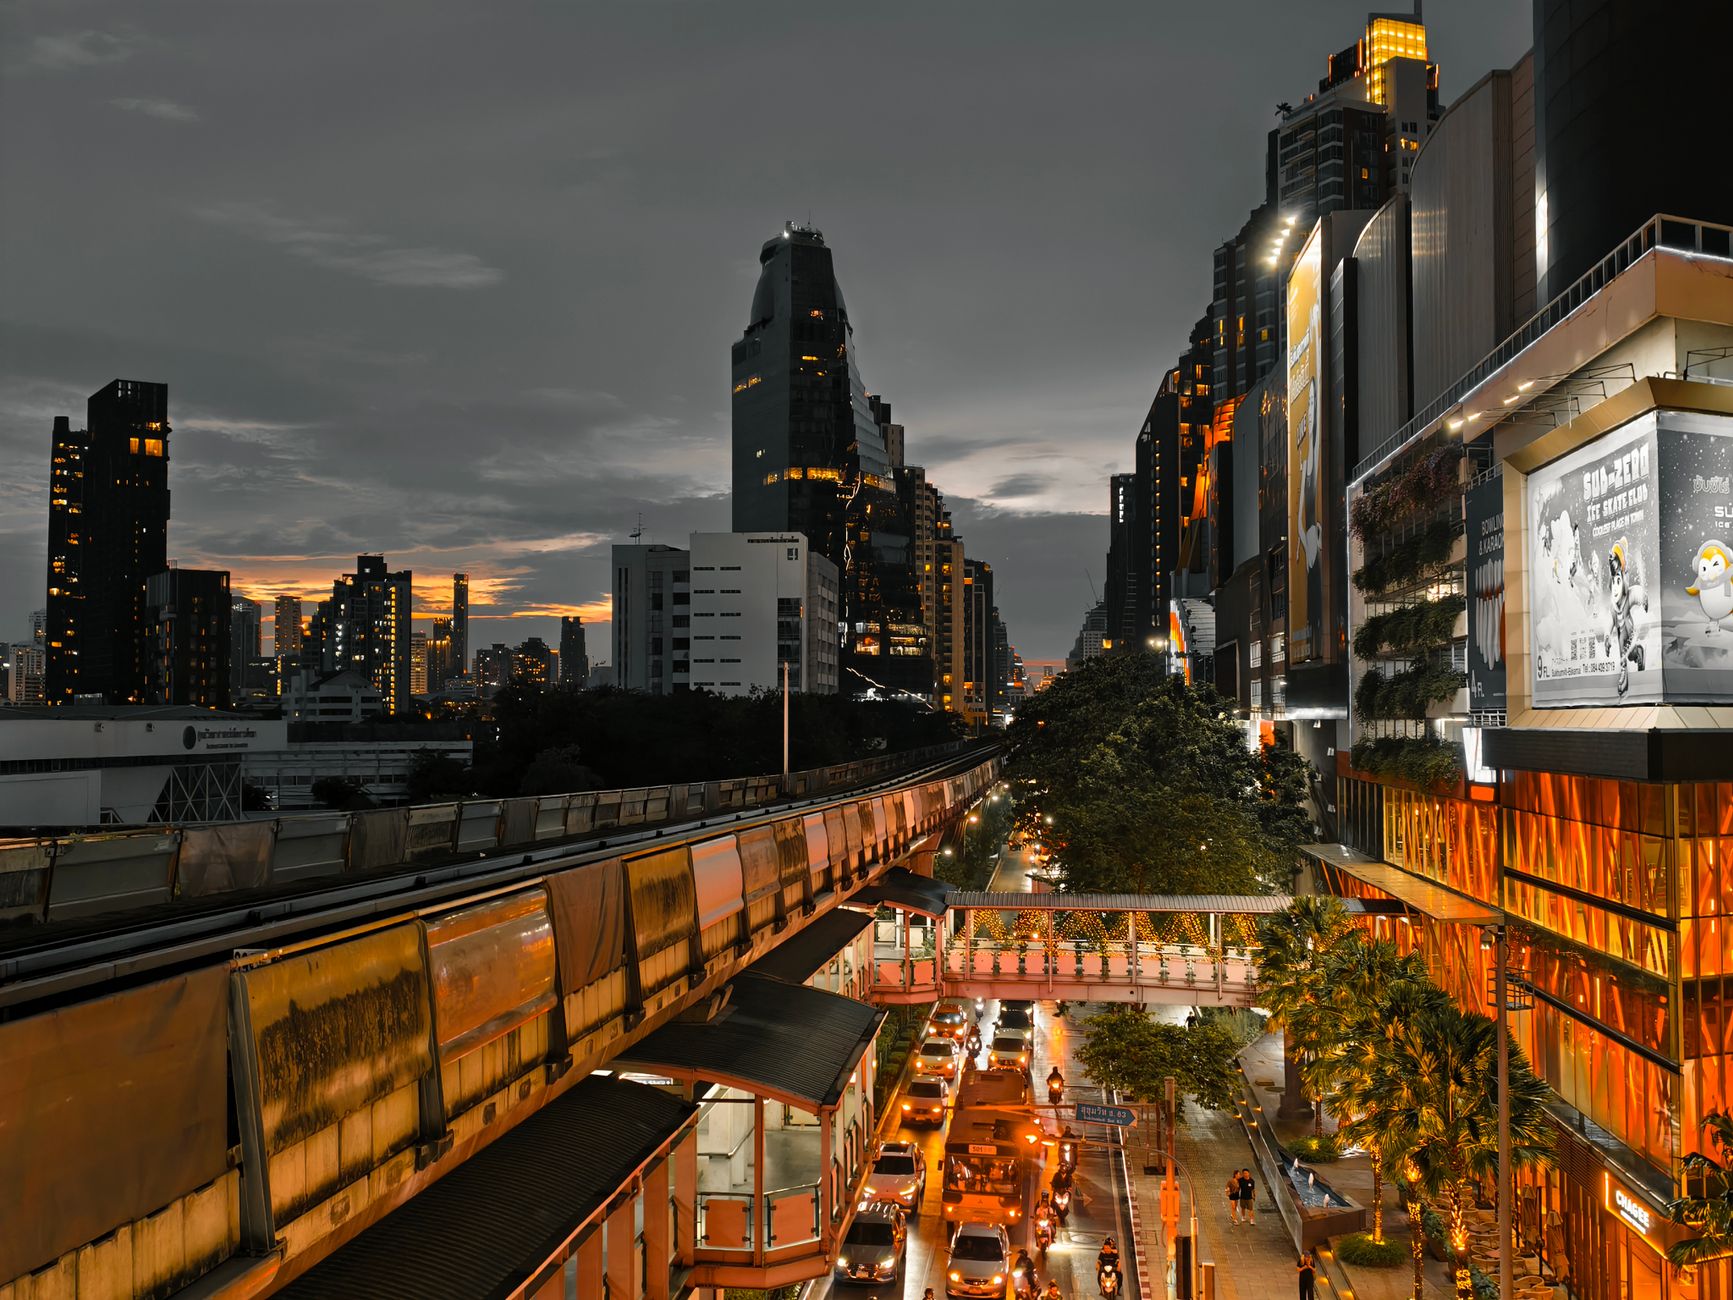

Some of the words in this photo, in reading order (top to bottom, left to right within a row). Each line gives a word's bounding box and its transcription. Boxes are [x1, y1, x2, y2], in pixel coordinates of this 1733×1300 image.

[1583, 443, 1650, 502] SUB-ZERO
[1602, 491, 1628, 517] SKATE
[1537, 655, 1543, 679] 9
[1471, 669, 1477, 699] 4
[1615, 1190, 1650, 1228] CHAGEE
